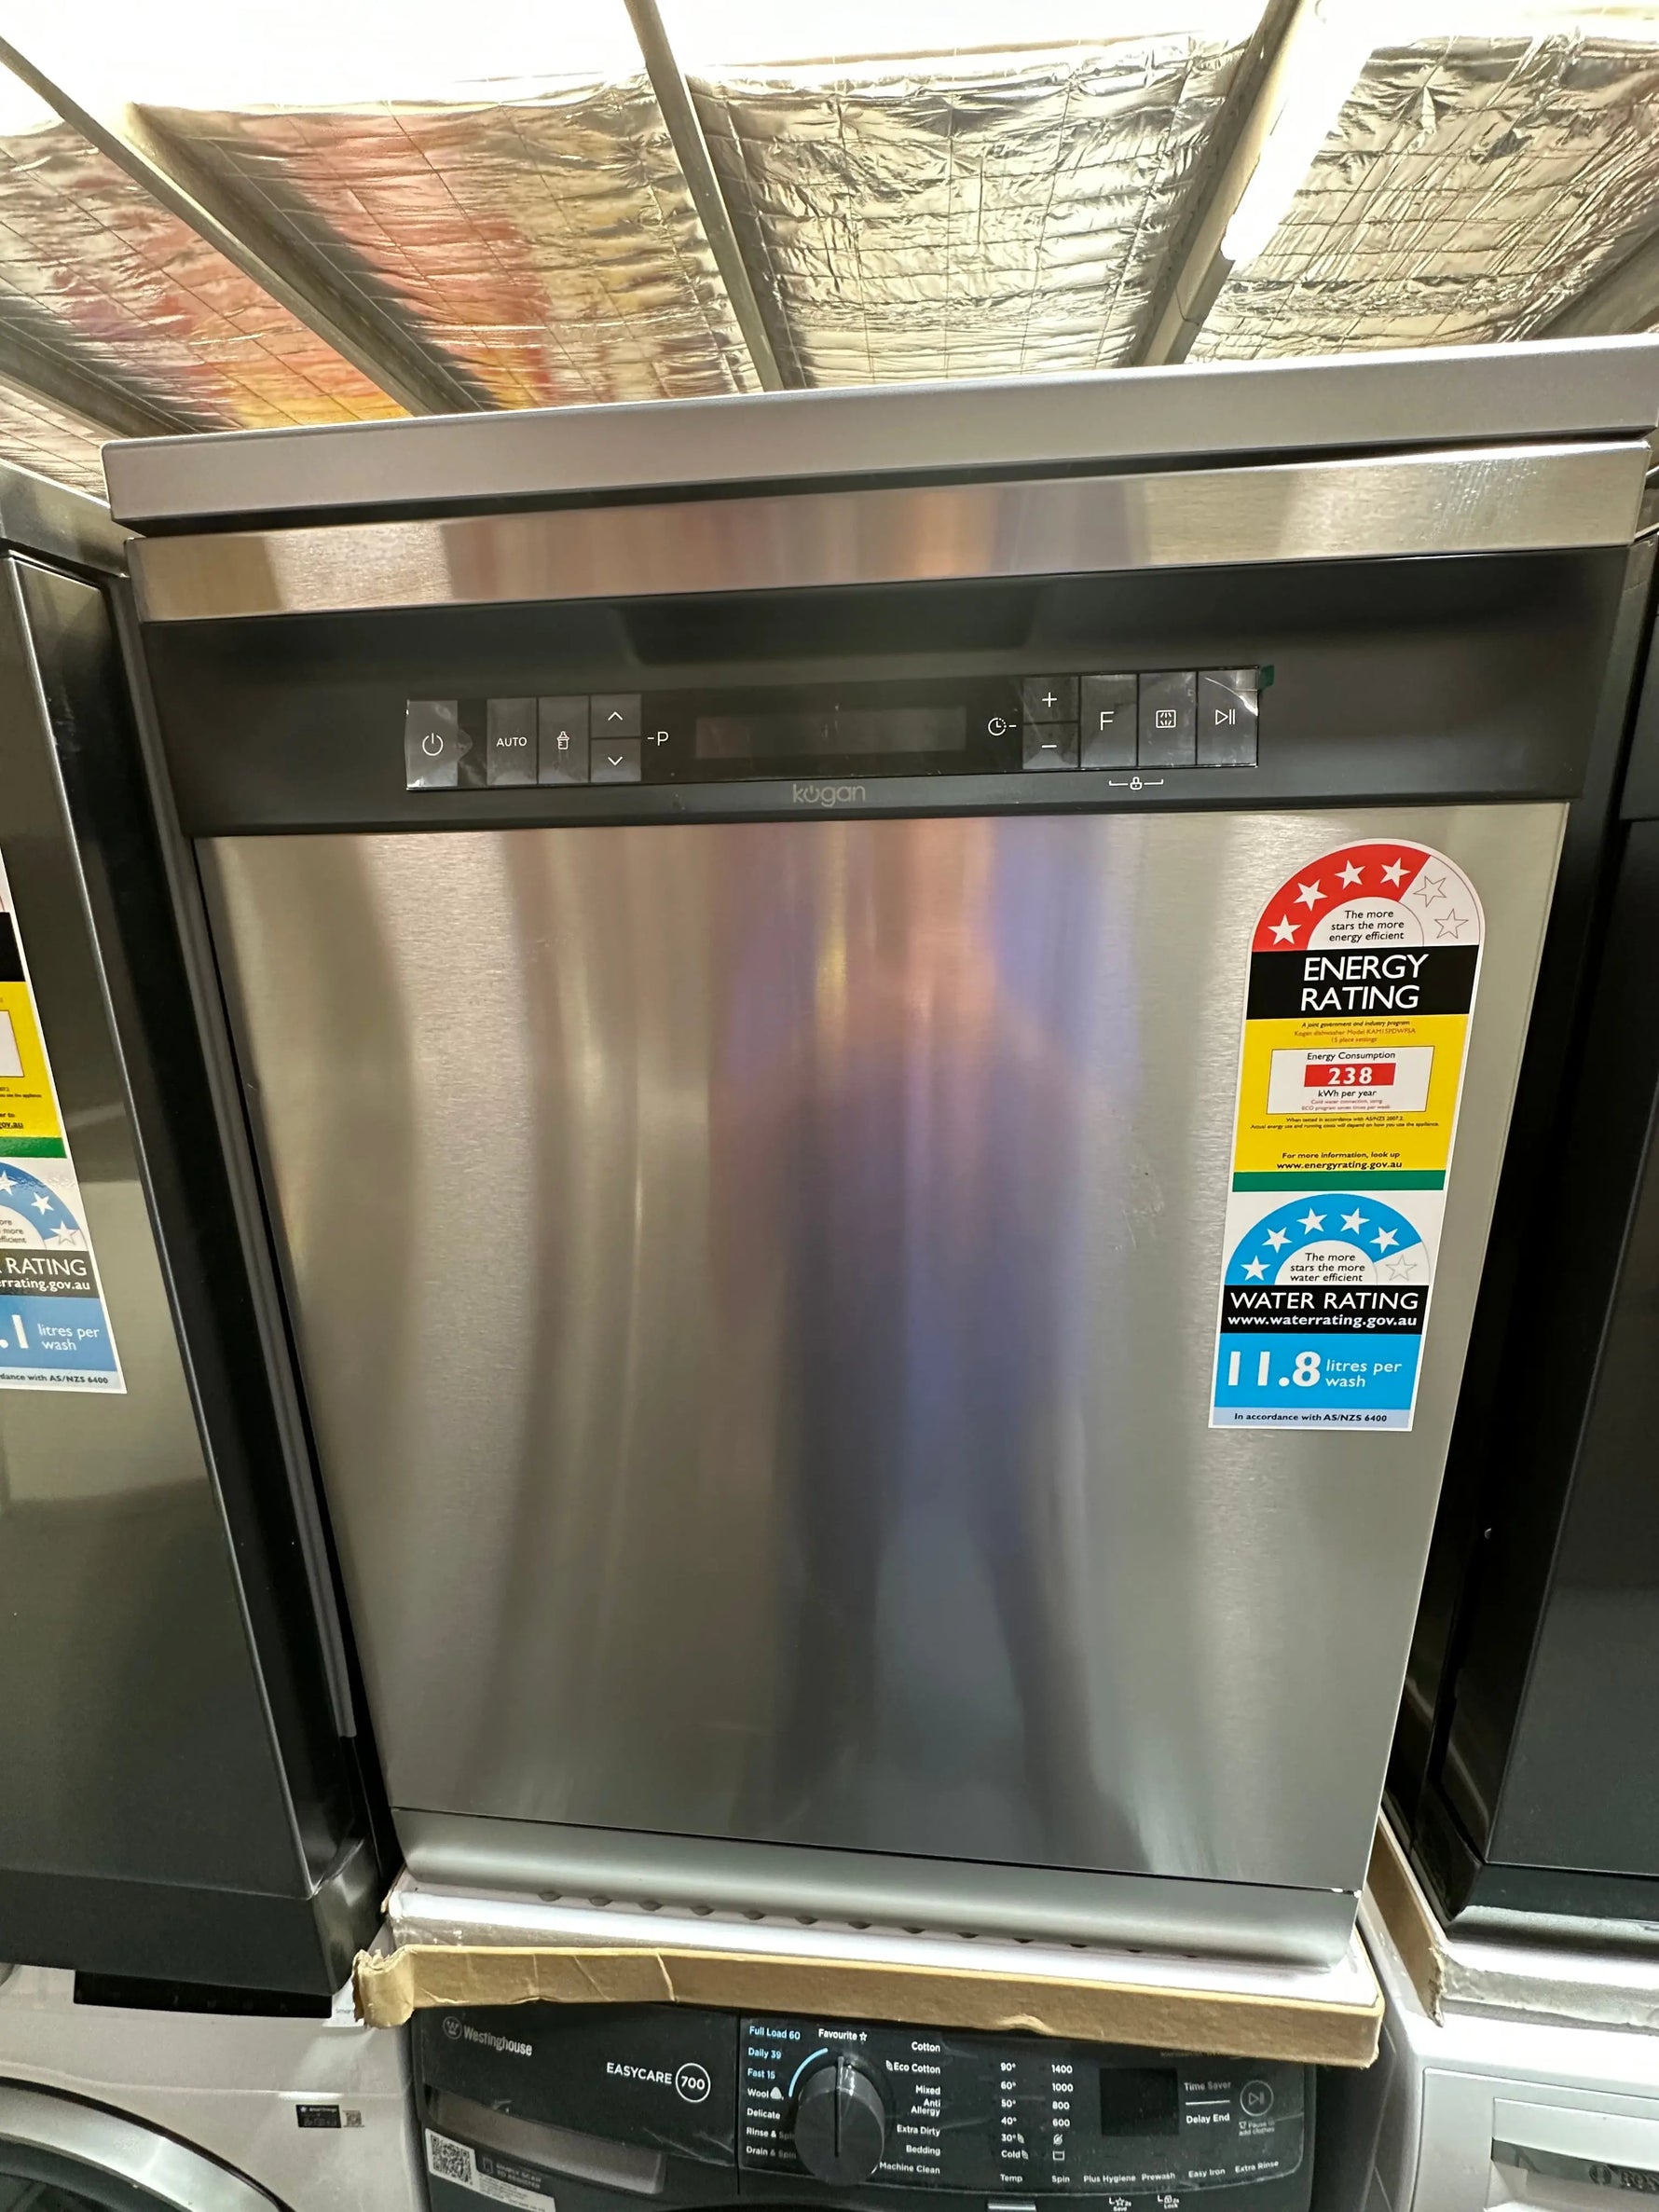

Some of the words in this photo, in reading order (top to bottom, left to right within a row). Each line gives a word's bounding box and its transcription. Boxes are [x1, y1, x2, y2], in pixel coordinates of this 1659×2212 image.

[1100, 711, 1115, 731] F
[496, 736, 528, 748] AUTO
[792, 783, 866, 807] kogan
[1344, 909, 1364, 919] The
[1366, 910, 1393, 919] more
[1331, 921, 1354, 930] stars
[1357, 920, 1375, 930] the
[1378, 921, 1405, 929] more
[1329, 932, 1362, 943] energy
[1364, 930, 1405, 941] efficient
[1303, 954, 1429, 982] ENERGY
[1300, 985, 1420, 1011] RATING
[1307, 1052, 1337, 1062] Energy
[1337, 1051, 1396, 1061] Consumption
[1327, 1066, 1373, 1085] 238
[1340, 1090, 1356, 1099] per
[1357, 1090, 1378, 1098] year
[1320, 1151, 1369, 1160] information,
[1276, 1161, 1403, 1171] www.energyrating.gov.au
[1304, 1253, 1325, 1262] The
[1327, 1254, 1356, 1262] more
[5, 1257, 88, 1276] RATING
[1290, 1263, 1315, 1272] stars
[1318, 1263, 1335, 1271] the
[1337, 1264, 1365, 1272] more
[1290, 1273, 1321, 1283] water
[1323, 1272, 1364, 1283] efficient
[1229, 1292, 1315, 1310] WATER
[1323, 1292, 1419, 1310] RATING
[1227, 1313, 1418, 1328] www.waterrating.gov.au
[37, 1323, 73, 1337] litres
[76, 1327, 100, 1341] per
[41, 1338, 77, 1351] wash
[1227, 1351, 1322, 1387] 11.8
[1325, 1359, 1367, 1372] litres
[1373, 1362, 1403, 1376] per
[27, 1373, 48, 1381] with
[49, 1375, 86, 1383] AS/NZS
[88, 1376, 109, 1384] 6400
[1325, 1374, 1365, 1388] wash
[1245, 1413, 1299, 1422] accordance
[1301, 1413, 1322, 1422] with
[1323, 1413, 1363, 1422] AS/NZS
[1364, 1414, 1388, 1422] 6400
[749, 2026, 765, 2037] Full
[766, 2027, 787, 2039] Load
[788, 2030, 801, 2040] 60
[818, 2028, 858, 2040] Favourite
[463, 2025, 533, 2057] Westinghouse
[911, 2041, 941, 2053] Cotton
[747, 2047, 769, 2059] Daily
[771, 2050, 781, 2059] 39
[747, 2068, 765, 2079] Fast
[767, 2070, 775, 2080] 15
[893, 2062, 910, 2072] Eco
[911, 2063, 941, 2075] Cotton
[1050, 2064, 1073, 2075] 1400
[606, 2061, 672, 2084] EASYCARE
[680, 2075, 706, 2091] 700
[915, 2084, 941, 2095] Mixed
[1051, 2082, 1074, 2093] 1000
[1184, 2081, 1206, 2092] Time
[1207, 2081, 1231, 2090] Saver
[747, 2088, 769, 2098] Wool
[923, 2098, 941, 2109] Anti
[1051, 2100, 1070, 2110] 800
[747, 2108, 781, 2120] Delicate
[911, 2106, 941, 2117] Allergy
[1052, 2118, 1071, 2128] 600
[1186, 2114, 1211, 2124] Delay
[1213, 2112, 1230, 2123] End
[746, 2126, 769, 2138] Rinse
[770, 2129, 777, 2138] &
[897, 2123, 919, 2135] Extra
[920, 2126, 940, 2137] Dirty
[746, 2145, 769, 2156] Drain
[770, 2147, 776, 2157] &
[906, 2144, 941, 2157] Bedding
[1000, 2150, 1021, 2160] Cold
[879, 2162, 914, 2172] Machine
[916, 2164, 940, 2175] Clean
[1187, 2168, 1208, 2179] Easy
[1209, 2166, 1226, 2177] Iron
[1235, 2164, 1255, 2174] Extra
[1256, 2160, 1280, 2170] Rinse
[1000, 2174, 1023, 2185] Temp
[1051, 2174, 1071, 2185] Spin
[1083, 2175, 1101, 2183] Plus
[1103, 2174, 1136, 2184] Hygiene
[1141, 2171, 1176, 2181] Prewash
